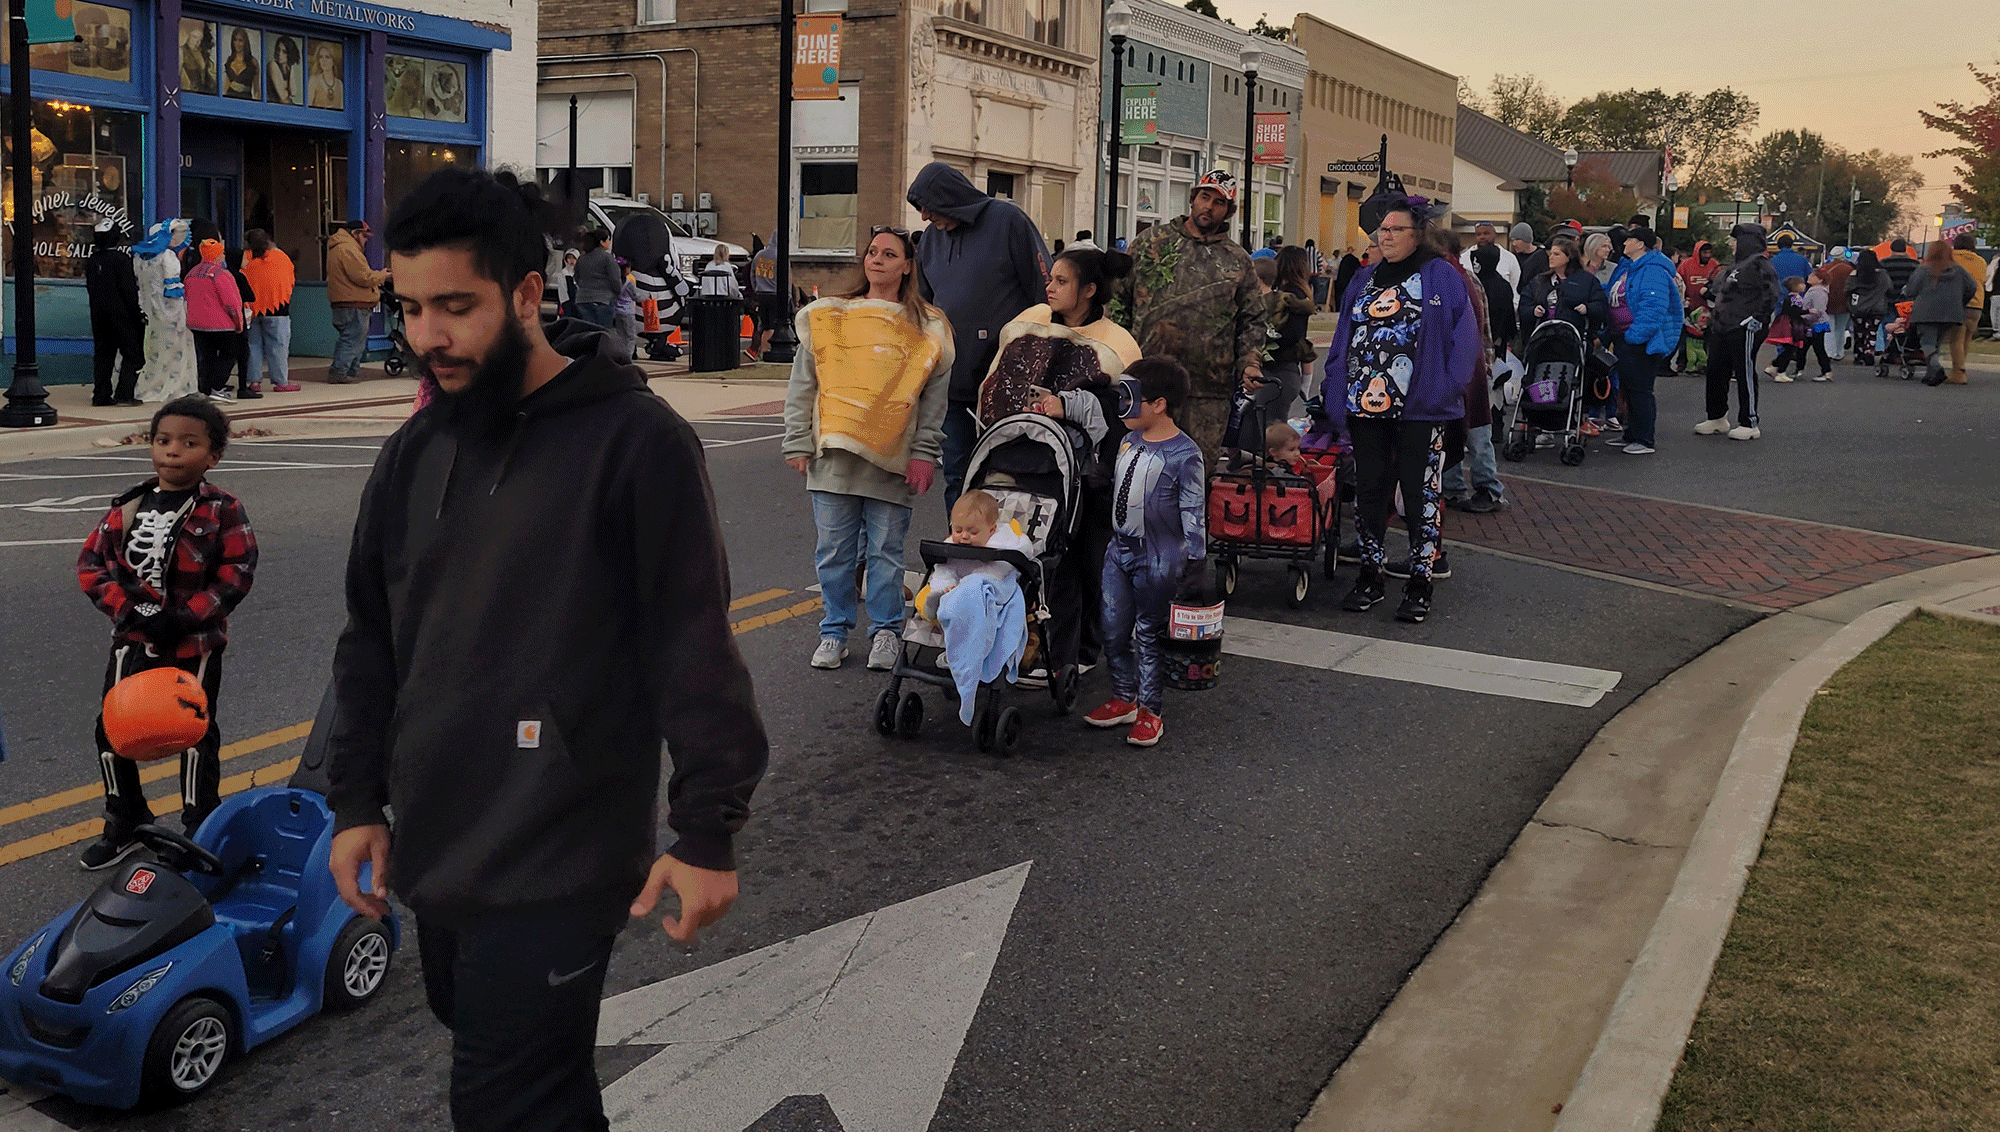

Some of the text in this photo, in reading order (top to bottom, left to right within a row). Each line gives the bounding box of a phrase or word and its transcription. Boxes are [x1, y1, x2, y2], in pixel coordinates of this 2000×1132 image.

[310, 0, 415, 31] METALWORKS
[798, 34, 839, 50] DINE
[796, 49, 839, 64] HERE
[1125, 97, 1157, 106] EXPLORE
[1125, 106, 1157, 119] HERE
[1257, 124, 1285, 133] SHOP
[1255, 133, 1285, 142] HERE
[1328, 163, 1375, 172] CHOCCOLOCCO
[1940, 223, 1974, 240] TACO
[32, 241, 63, 257] HOLE
